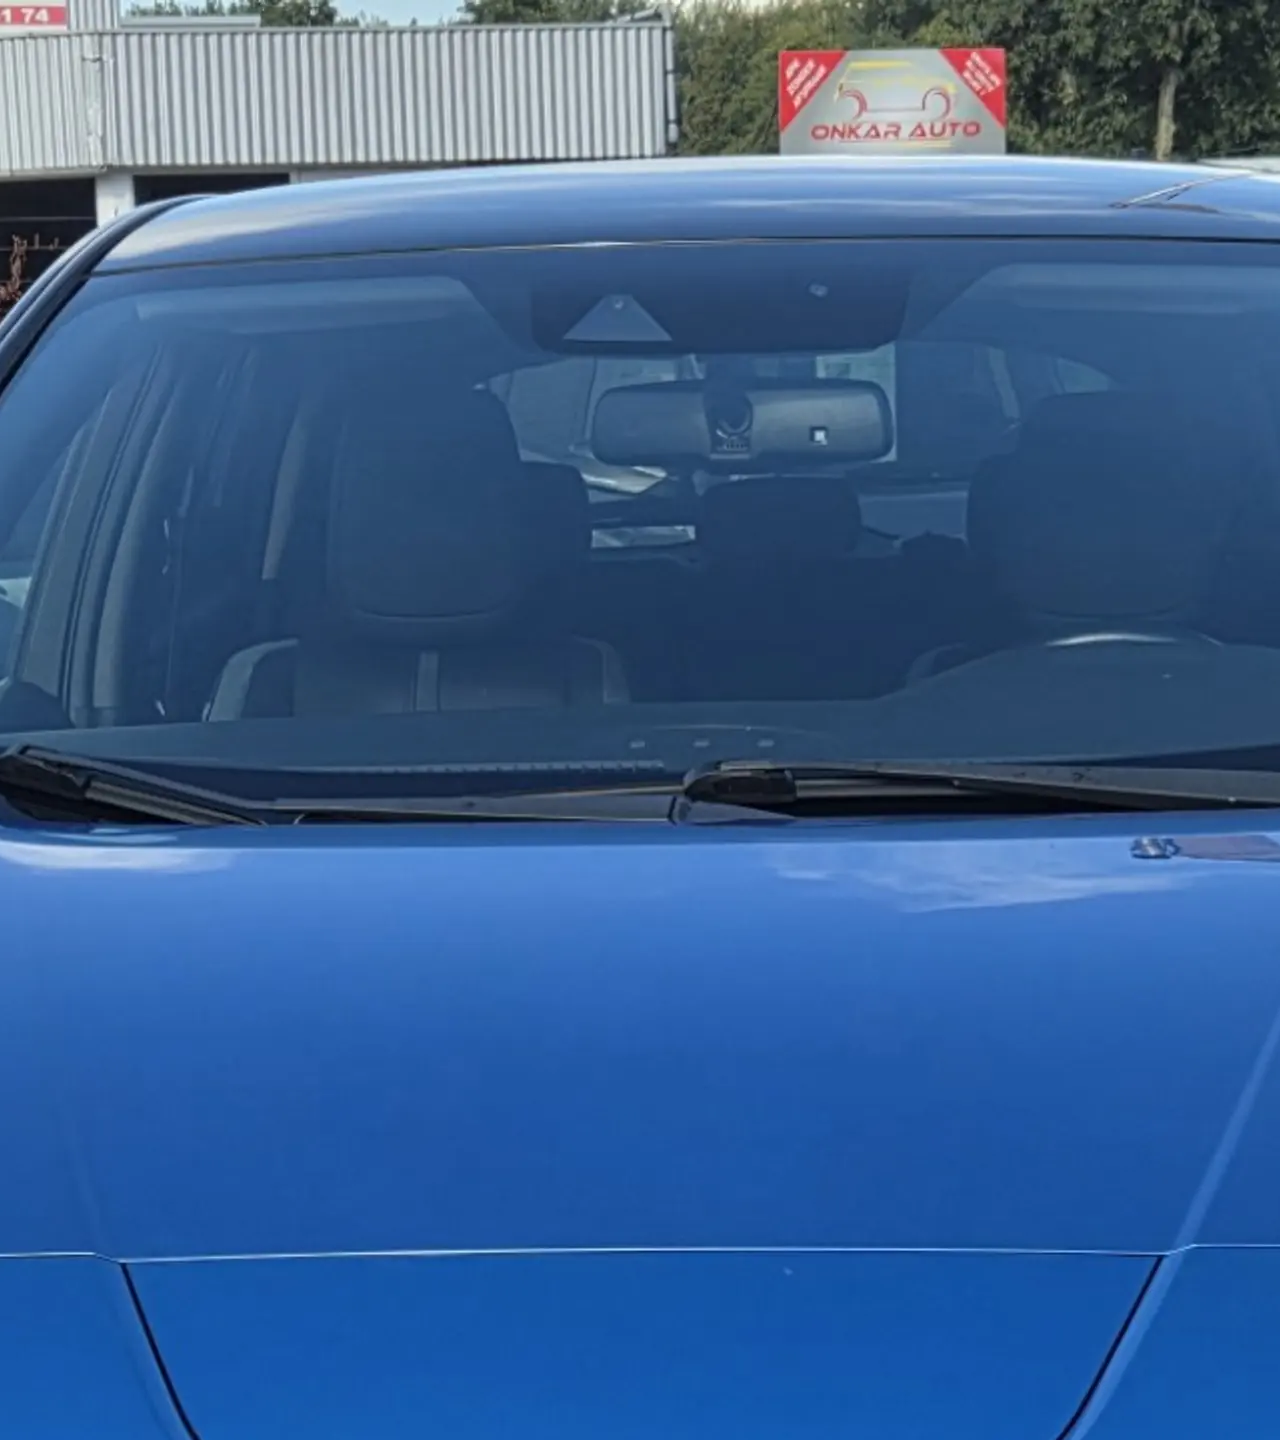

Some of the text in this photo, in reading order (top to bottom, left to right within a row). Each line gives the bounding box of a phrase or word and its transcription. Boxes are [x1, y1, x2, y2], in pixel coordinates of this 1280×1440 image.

[20, 8, 50, 22] 74
[811, 120, 983, 141] ONKAR AUTO
